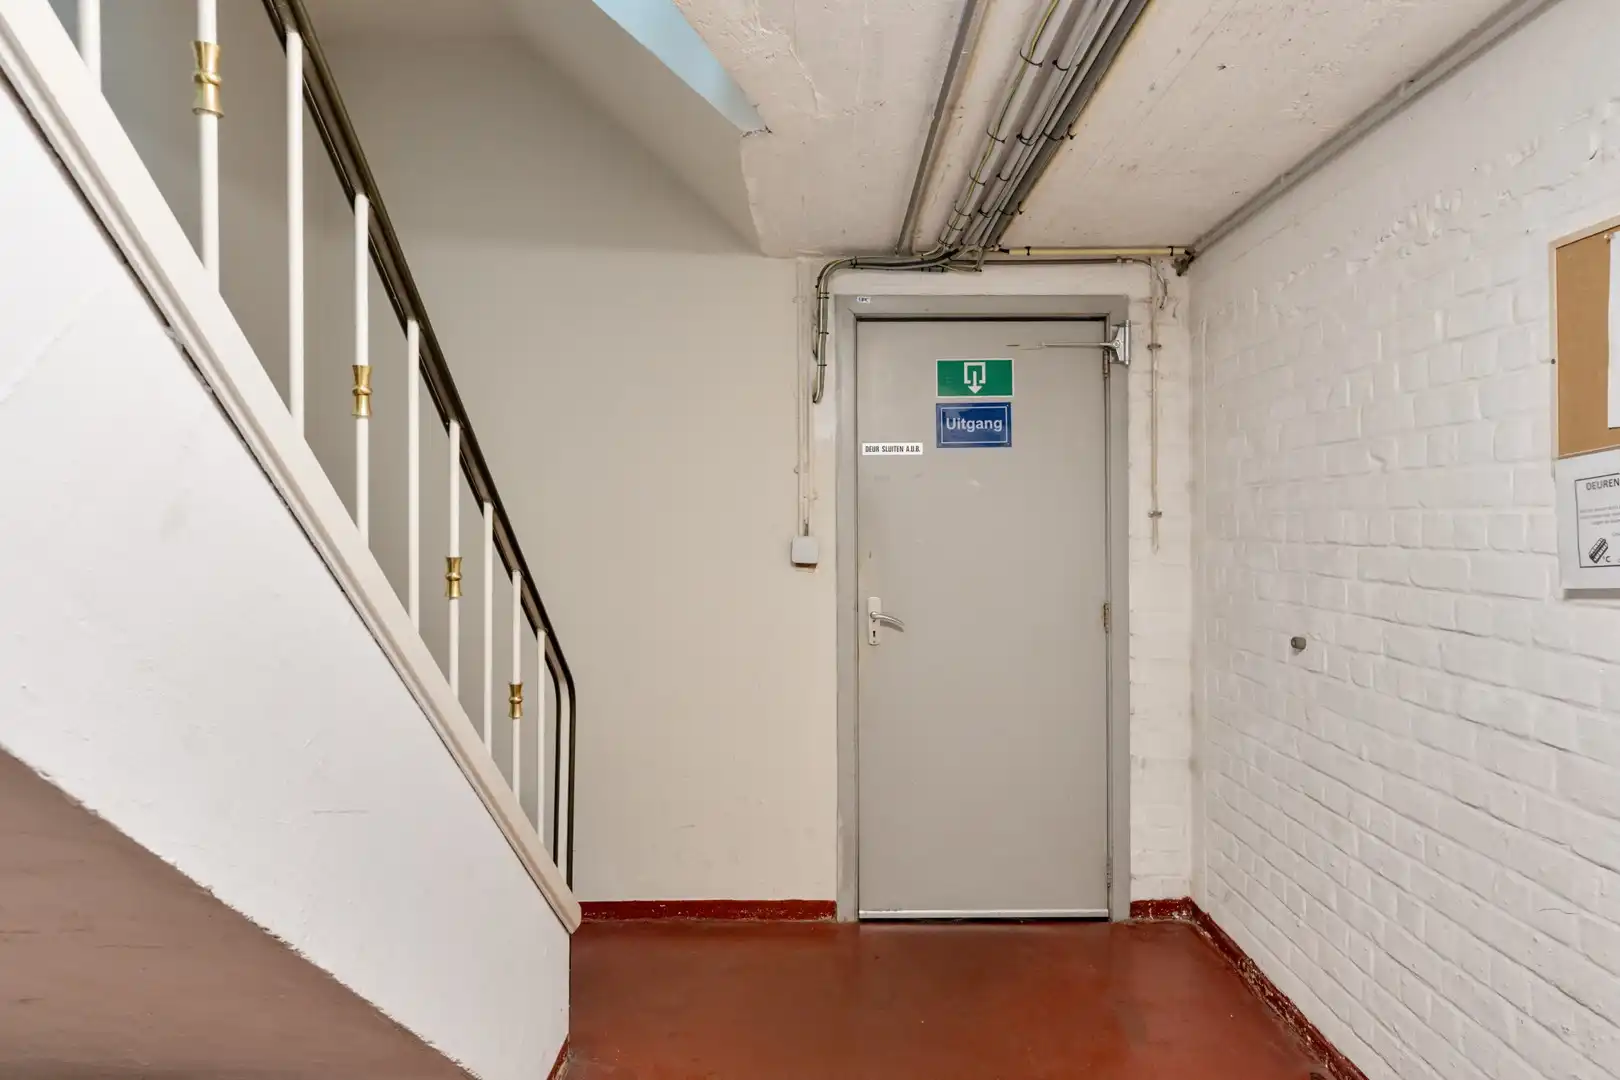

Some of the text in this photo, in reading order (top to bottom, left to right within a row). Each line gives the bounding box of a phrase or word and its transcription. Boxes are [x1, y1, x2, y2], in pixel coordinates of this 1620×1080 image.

[946, 417, 1002, 432] Uitgang
[865, 445, 880, 453] DEUR
[881, 445, 904, 453] SLUITEN
[1586, 478, 1620, 490] DEUREN
